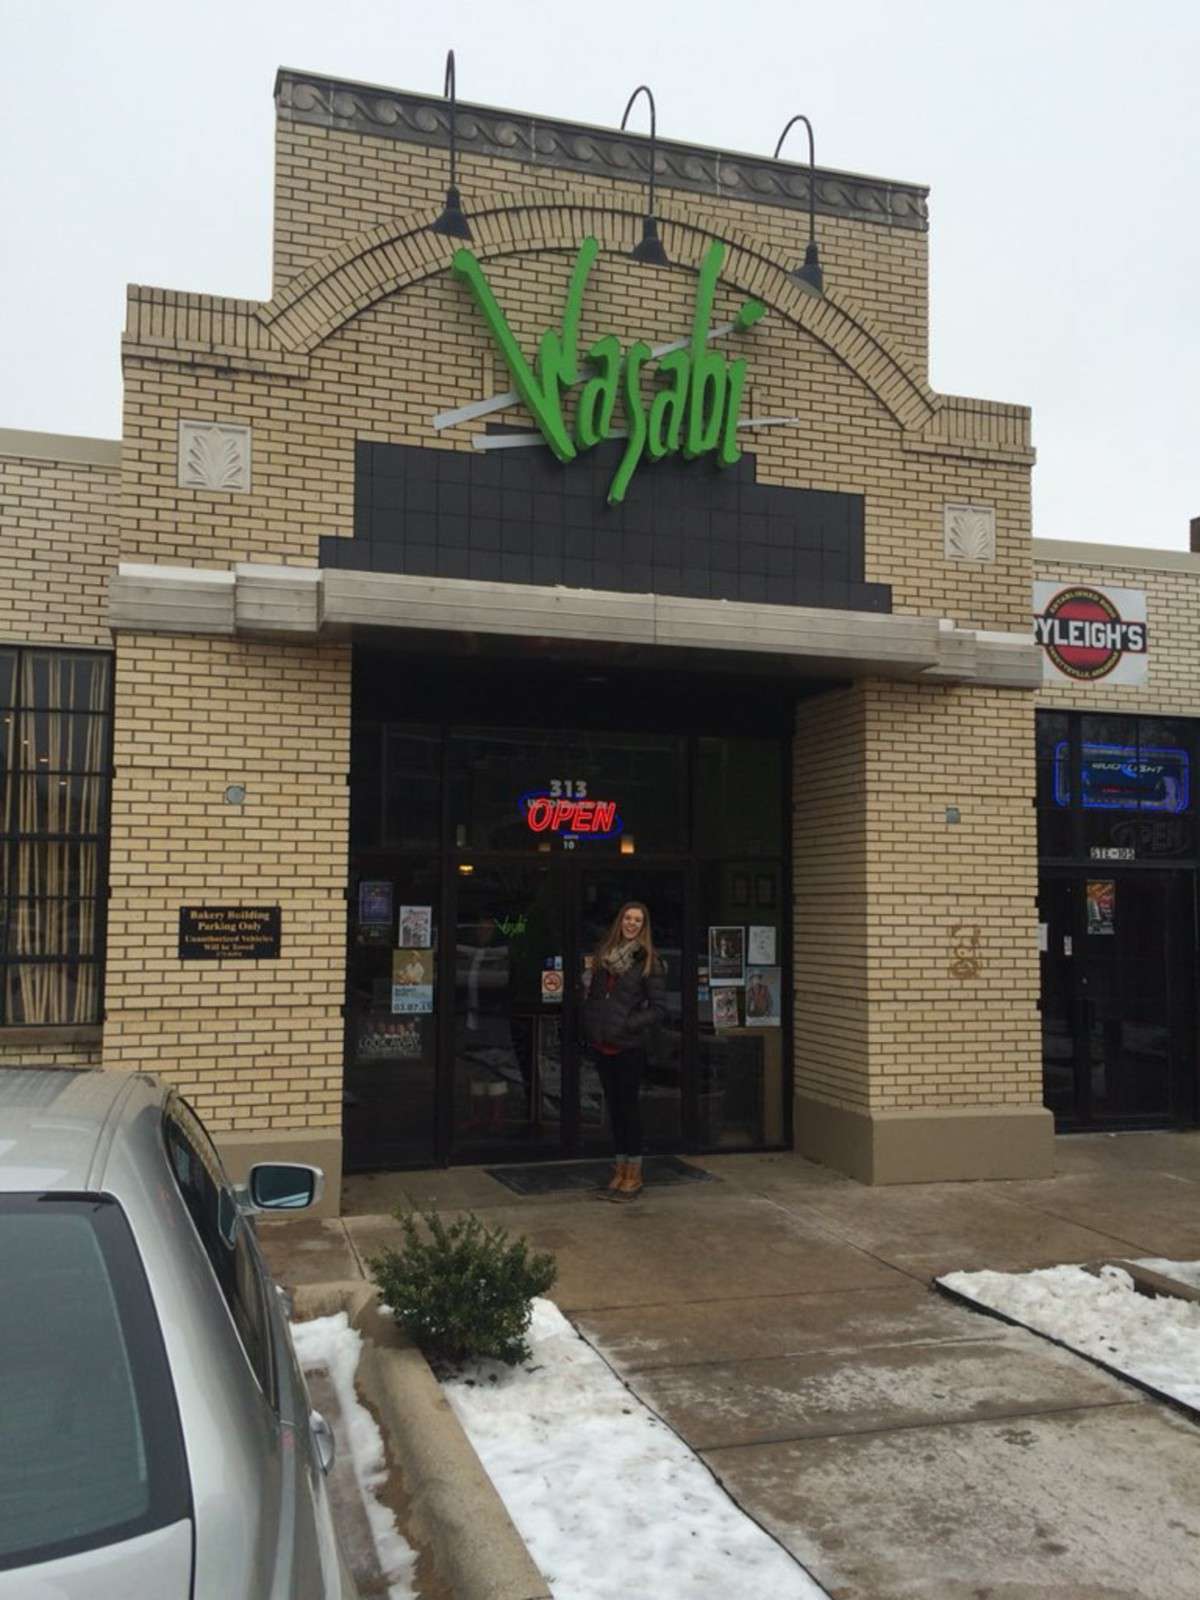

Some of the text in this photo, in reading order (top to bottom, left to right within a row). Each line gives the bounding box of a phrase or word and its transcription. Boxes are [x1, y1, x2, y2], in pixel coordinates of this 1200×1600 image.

[452, 235, 766, 504] Wasabi
[550, 780, 588, 798] 313
[528, 798, 616, 832] OPEN
[190, 911, 271, 921] Bakery Building
[198, 922, 262, 932] Parking Only
